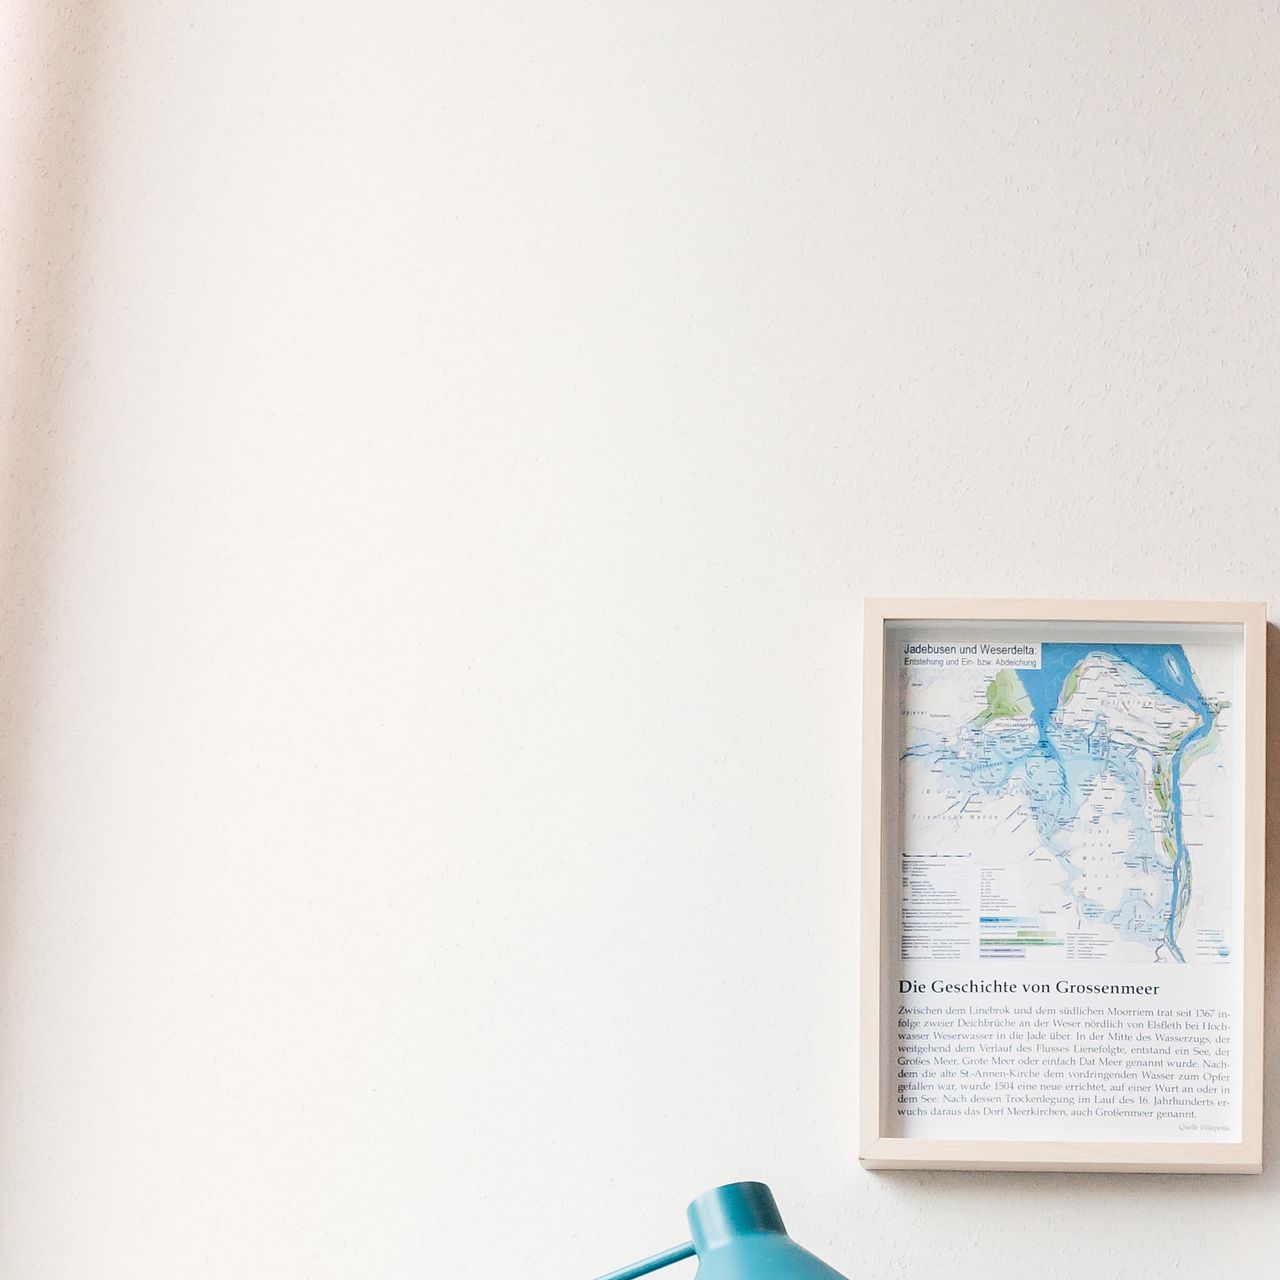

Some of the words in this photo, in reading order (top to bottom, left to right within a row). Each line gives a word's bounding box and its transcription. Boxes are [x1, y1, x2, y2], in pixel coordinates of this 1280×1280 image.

[904, 644, 956, 654] Jadebusen
[960, 644, 977, 654] und
[980, 645, 1037, 655] Weserdelta:
[904, 658, 944, 668] Entstehung
[946, 658, 959, 666] und
[995, 658, 1037, 668] Abdeichung
[898, 979, 926, 993] Die
[930, 980, 1017, 994] Geschichte
[1021, 985, 1050, 994] von
[1055, 980, 1160, 994] Grossenmeer
[897, 1005, 942, 1015] Zwischen
[945, 1005, 966, 1015] dem
[1013, 1006, 1032, 1016] und
[1035, 1006, 1056, 1016] dem
[1058, 1007, 1104, 1017] südlichen
[1156, 1007, 1173, 1017] trat
[1175, 1008, 1192, 1018] seit
[1196, 1008, 1215, 1018] 1367
[898, 1018, 920, 1030] folge
[923, 1018, 954, 1028] zweier
[957, 1018, 1016, 1028] Deichbrüche
[1033, 1019, 1049, 1029] der
[1052, 1019, 1081, 1029] Weser
[1084, 1019, 1123, 1029] nördlich
[1185, 1020, 1199, 1030] bei
[933, 1031, 993, 1041] Weserwasser
[995, 1031, 1006, 1041] in
[1008, 1031, 1024, 1041] die
[1027, 1032, 1046, 1044] Jade
[1076, 1032, 1086, 1042] In
[1088, 1032, 1104, 1042] der
[1107, 1032, 1133, 1042] Mitte
[1135, 1033, 1152, 1043] des
[1214, 1034, 1230, 1044] der
[898, 1043, 951, 1055] weitgehend
[954, 1043, 975, 1053] dem
[979, 1044, 1012, 1054] Verlauf
[1016, 1044, 1032, 1054] des
[1036, 1044, 1070, 1054] Flusses
[1130, 1045, 1170, 1055] entstand
[1174, 1046, 1189, 1056] ein
[1214, 1046, 1230, 1056] der
[897, 1055, 930, 1066] Großes
[961, 1056, 988, 1066] Grote
[991, 1056, 1015, 1066] Meer
[1017, 1057, 1039, 1067] oder
[1041, 1057, 1076, 1067] einfach
[1079, 1057, 1095, 1067] Dat
[1098, 1058, 1122, 1068] Meer
[1126, 1058, 1163, 1071] genannt
[897, 1068, 918, 1078] dem
[922, 1068, 936, 1078] die
[940, 1068, 957, 1078] alte
[960, 1069, 1040, 1079] St.-Annen-Kirche
[1043, 1069, 1064, 1079] dem
[1068, 1070, 1138, 1082] vordringenden
[1142, 1071, 1174, 1081] Wasser
[1202, 1071, 1230, 1084] Opfer
[897, 1081, 934, 1093] gefallen
[960, 1081, 991, 1091] wurde
[995, 1082, 1014, 1092] 1504
[1017, 1082, 1037, 1092] eine
[1109, 1083, 1125, 1093] auf
[1127, 1083, 1151, 1093] einer
[1154, 1084, 1178, 1094] Wurt
[1196, 1084, 1217, 1094] oder
[1220, 1084, 1230, 1094] in
